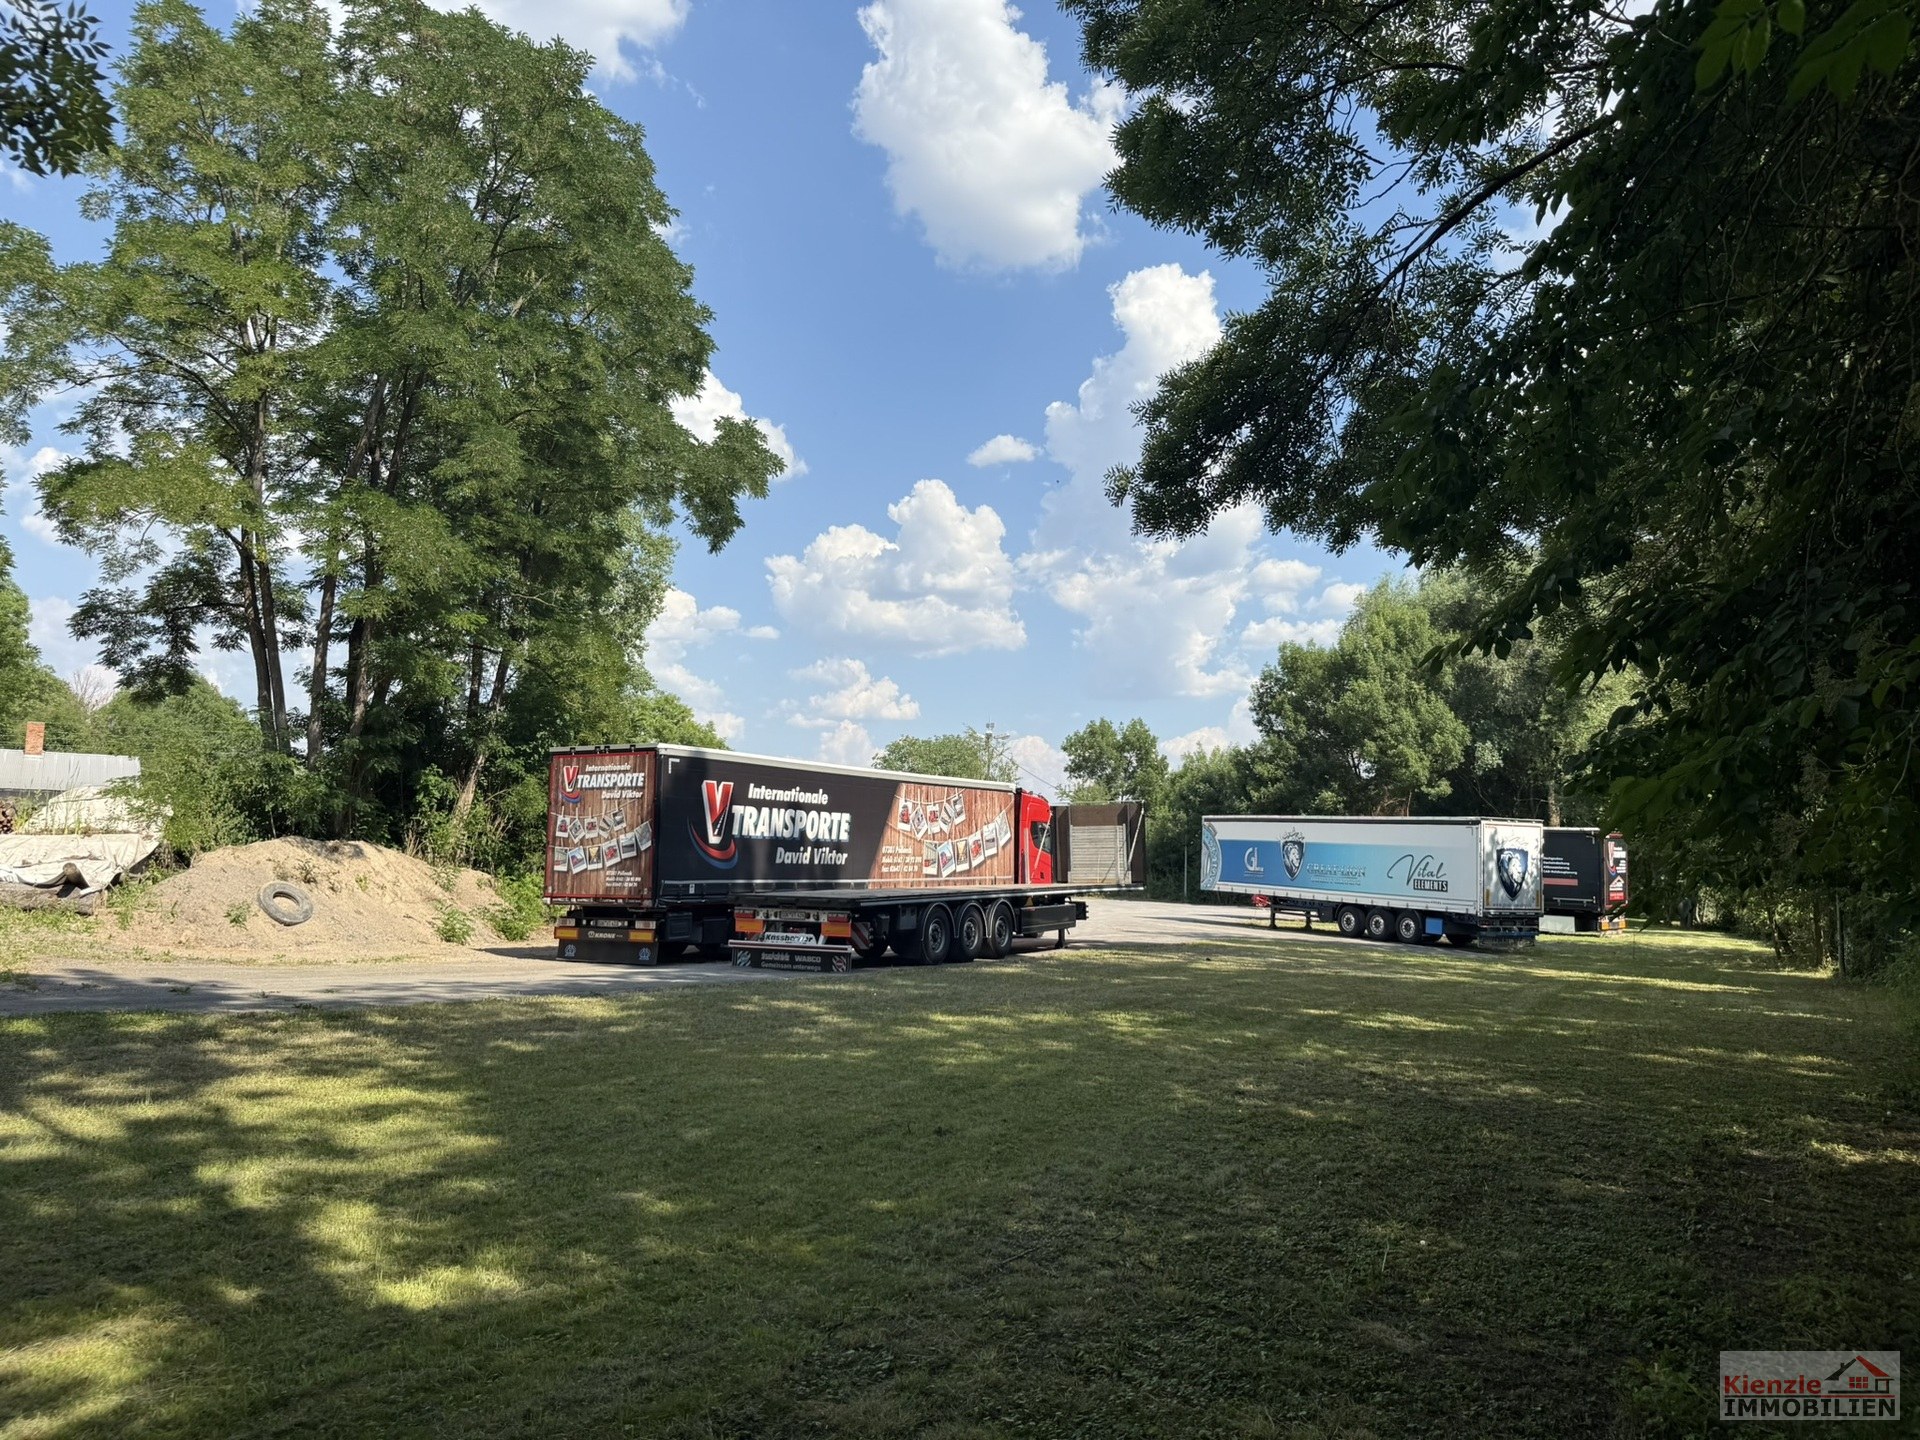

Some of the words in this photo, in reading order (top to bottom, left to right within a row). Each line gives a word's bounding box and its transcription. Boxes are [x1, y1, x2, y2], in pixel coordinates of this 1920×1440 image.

[585, 762, 631, 772] Internationale
[577, 773, 645, 788] TRANSPORTE
[601, 790, 621, 799] David
[622, 790, 643, 799] Viktor
[748, 783, 829, 805] Internationale
[731, 805, 851, 842] TRANSPORTE
[775, 846, 811, 864] David
[813, 847, 848, 865] Viktor
[1386, 854, 1447, 886] Vital
[1414, 880, 1447, 891] ELEMENTS
[794, 955, 822, 963] WABCO
